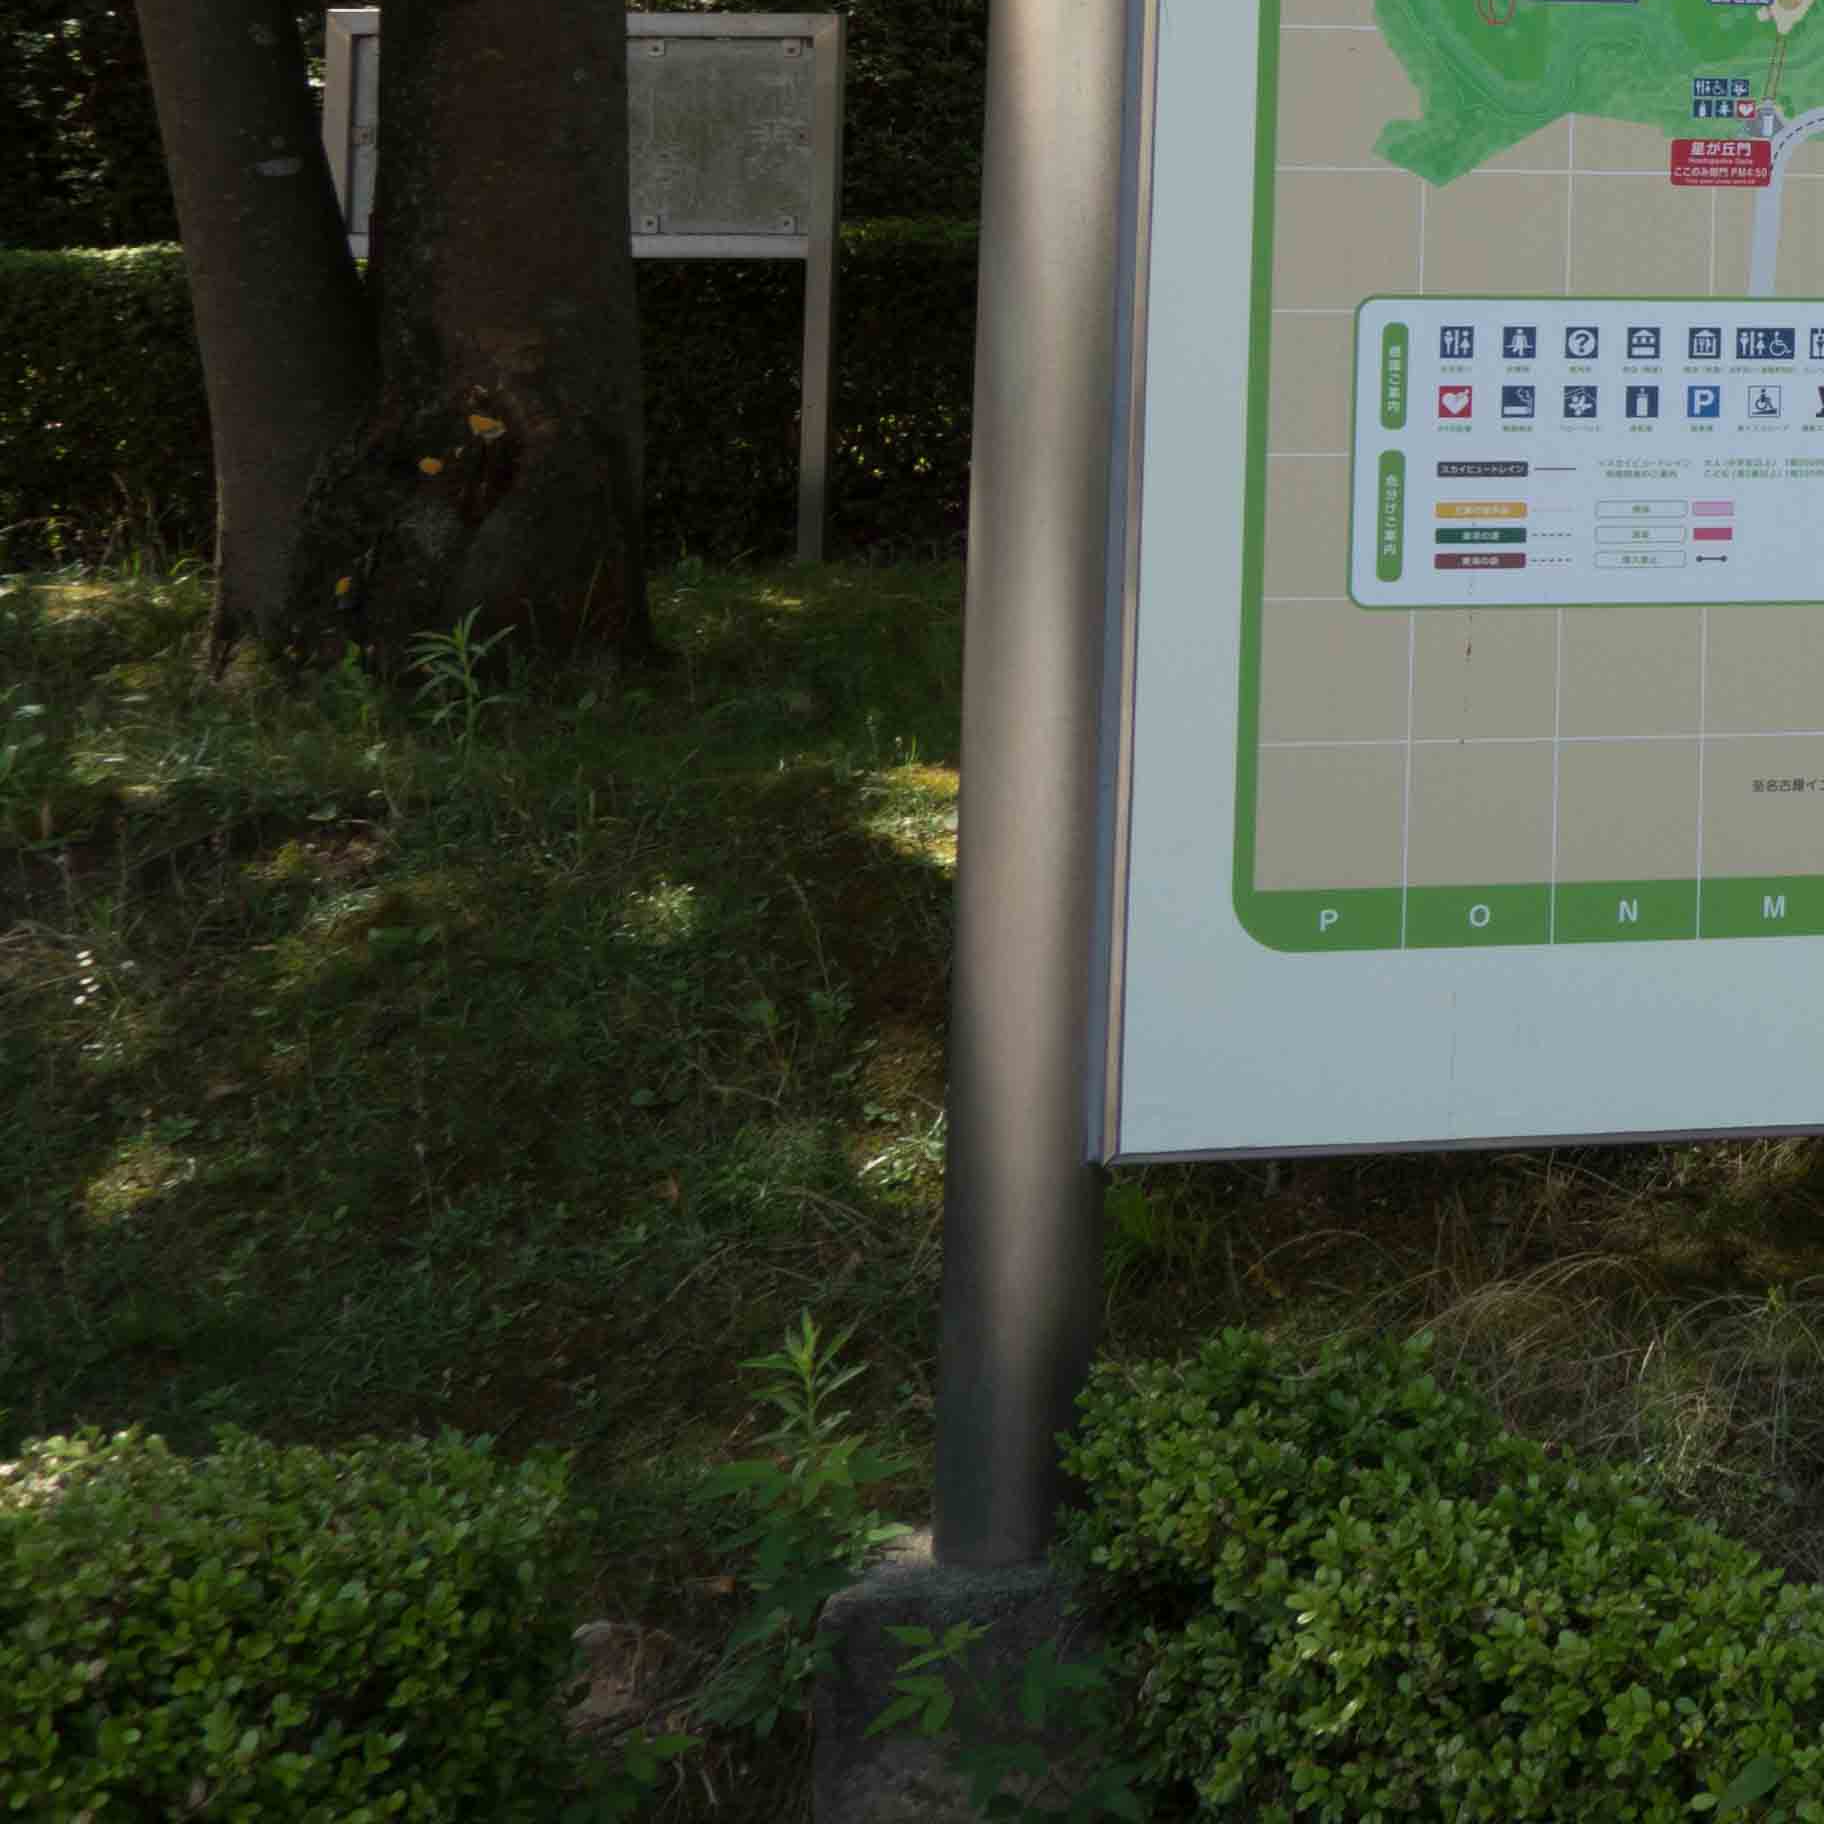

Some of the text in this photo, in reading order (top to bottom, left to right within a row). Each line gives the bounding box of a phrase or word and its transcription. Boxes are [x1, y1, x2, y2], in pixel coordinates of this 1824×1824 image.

[1469, 904, 1490, 927] O
[1619, 900, 1638, 922] N
[1763, 896, 1785, 919] M
[1320, 910, 1338, 932] P
